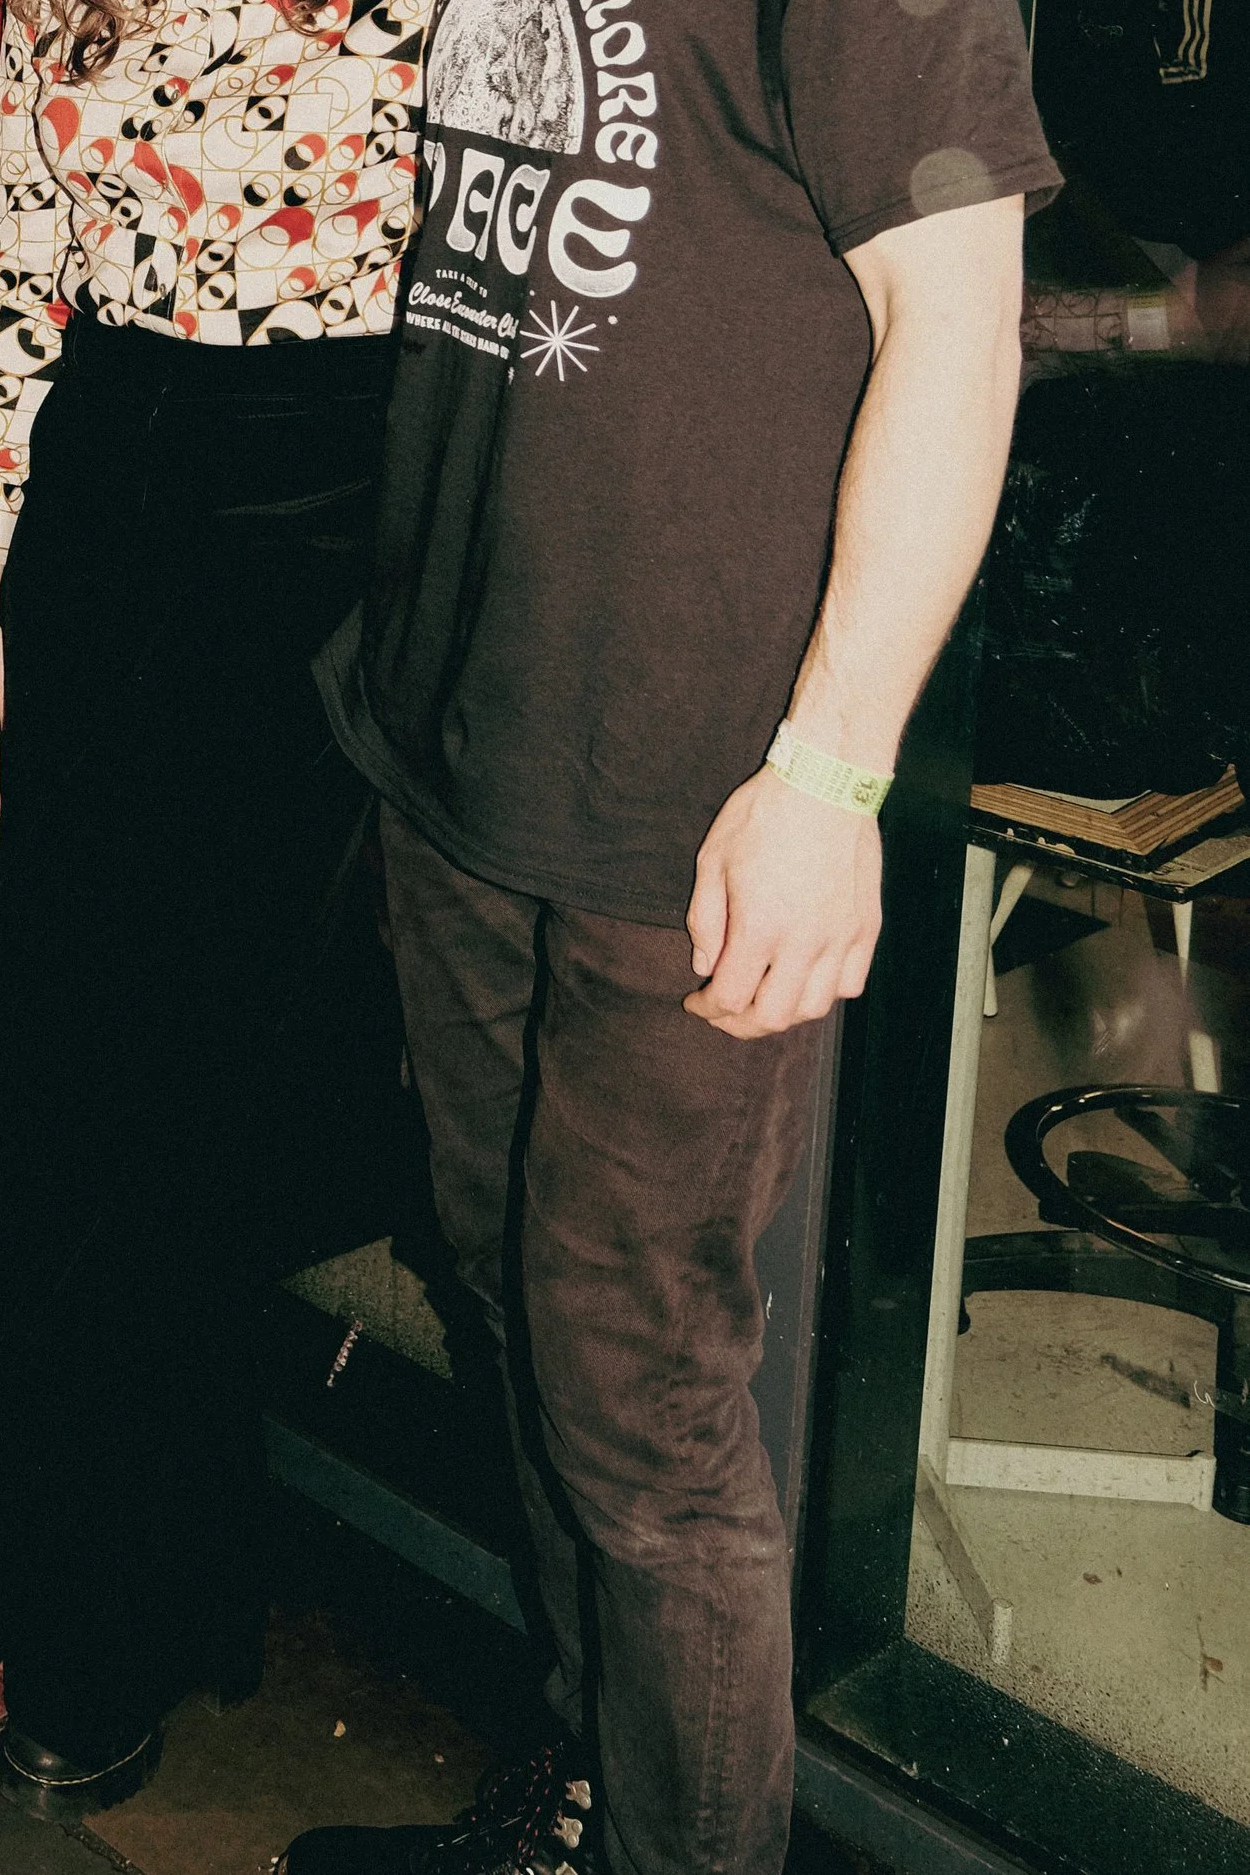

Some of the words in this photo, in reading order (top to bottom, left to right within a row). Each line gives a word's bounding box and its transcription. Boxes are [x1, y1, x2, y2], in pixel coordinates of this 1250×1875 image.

[424, 139, 651, 298] ACE
[436, 269, 459, 280] TAKE
[460, 273, 466, 283] A
[408, 281, 452, 309] Close
[406, 310, 441, 330] WHERE
